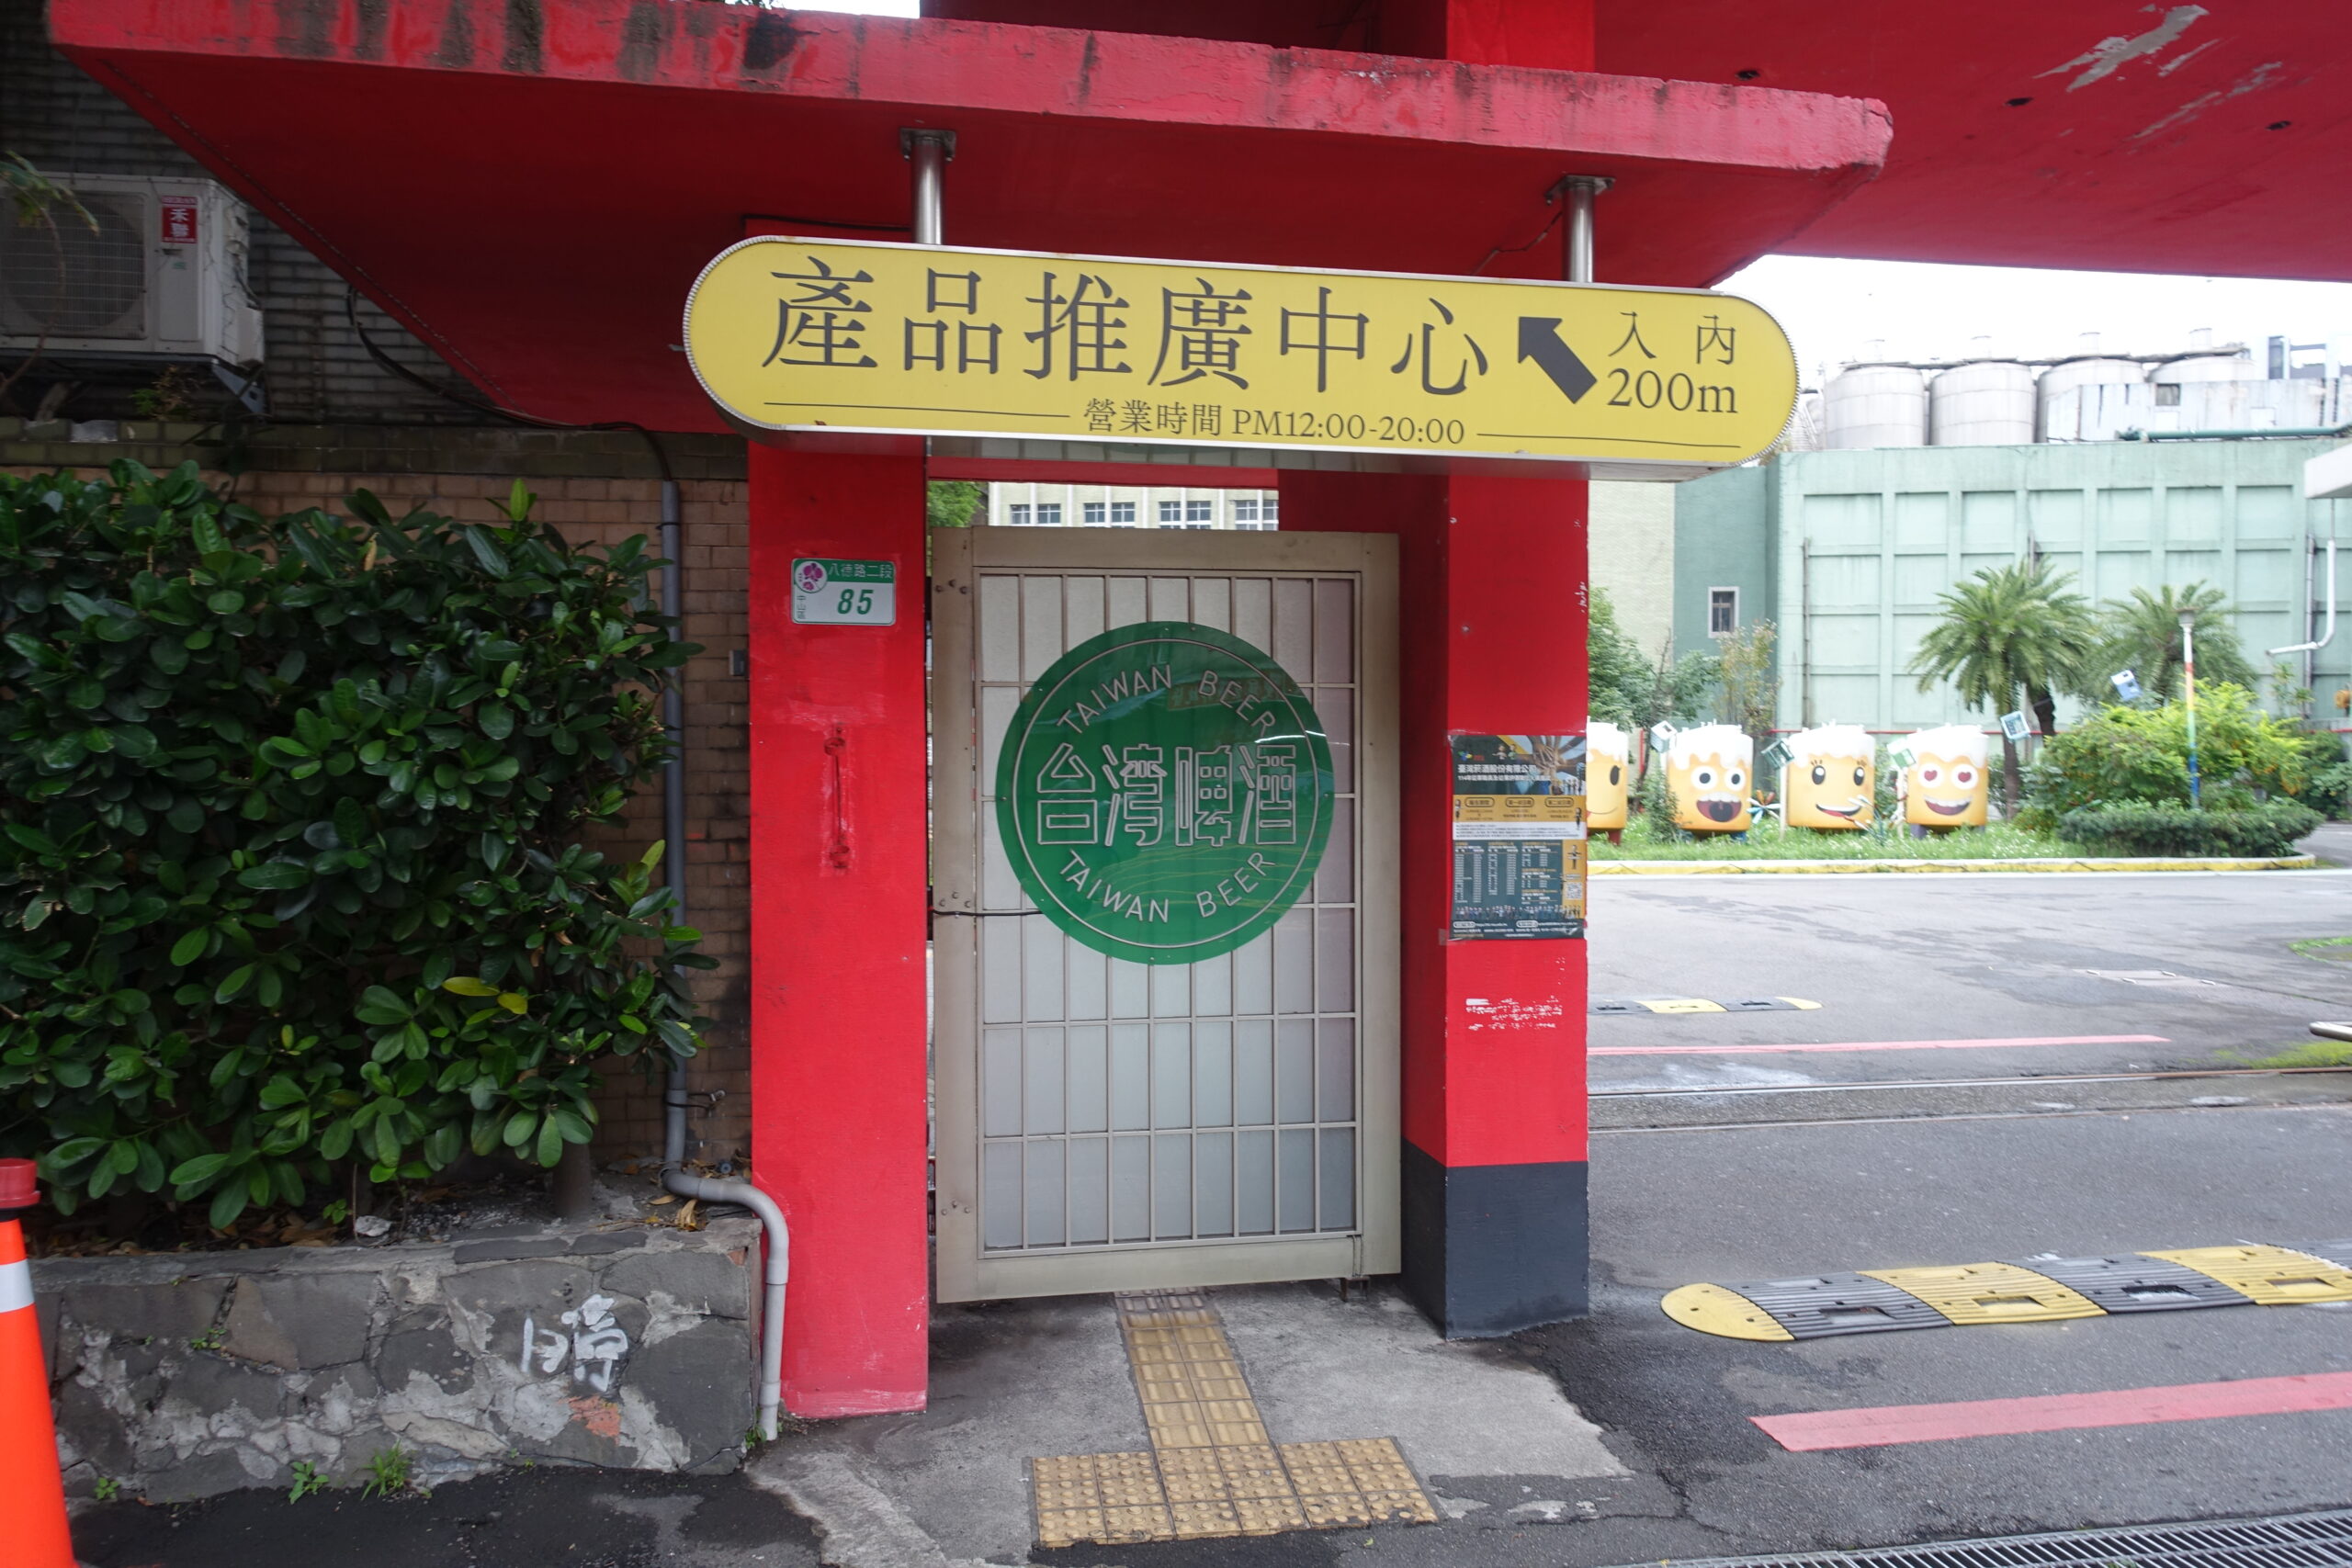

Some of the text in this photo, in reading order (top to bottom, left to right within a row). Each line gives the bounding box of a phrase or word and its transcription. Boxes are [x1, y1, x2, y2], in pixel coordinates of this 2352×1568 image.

[761, 255, 1489, 396] 產品推廣中心
[1607, 367, 1738, 414] 200m
[1083, 398, 1465, 446] 營業時間 PM12:00-20:00
[837, 588, 875, 615] 85
[1057, 663, 1276, 738] TAIWAN BEER
[1058, 850, 1276, 923] TAIWAN BEER
